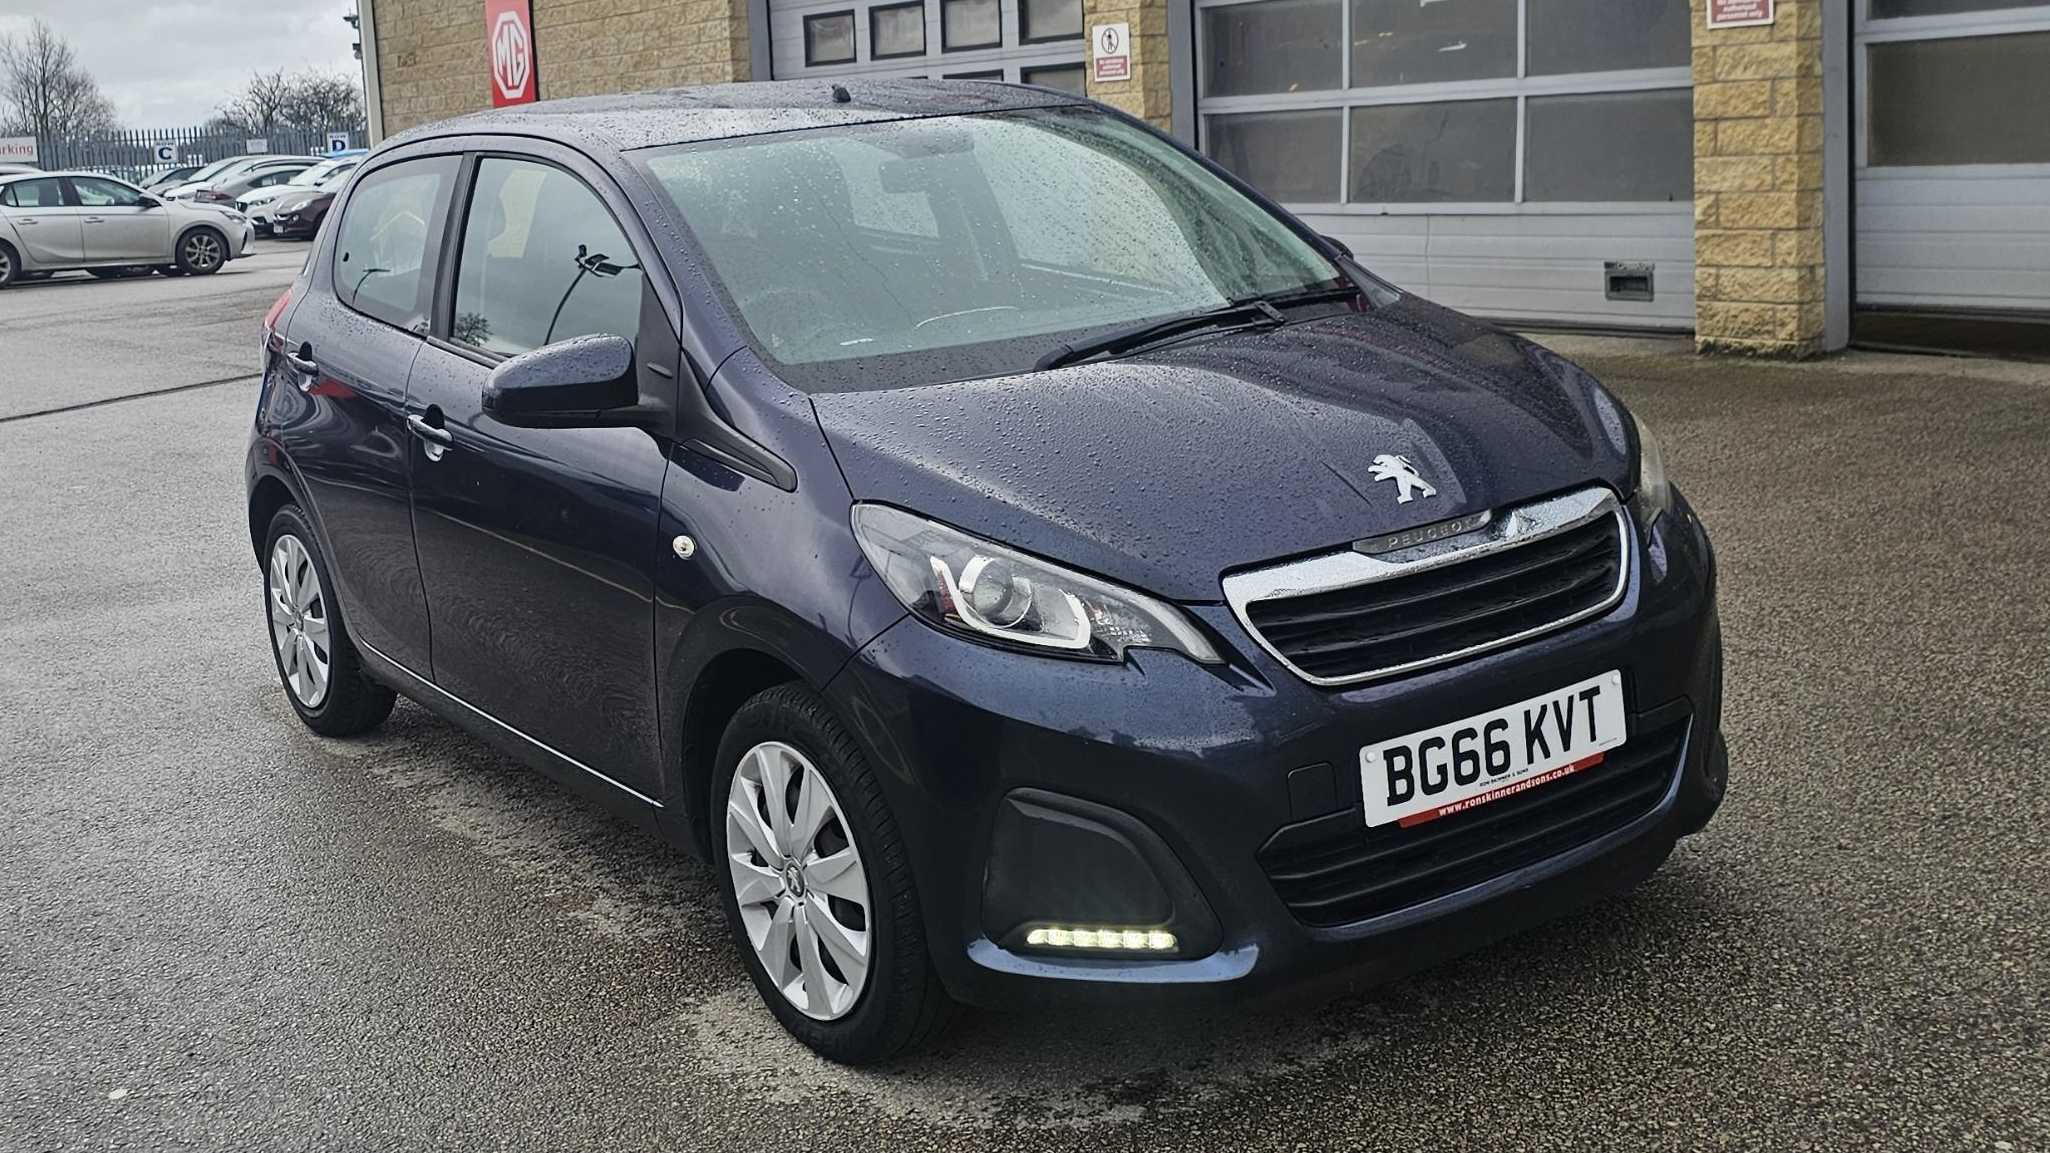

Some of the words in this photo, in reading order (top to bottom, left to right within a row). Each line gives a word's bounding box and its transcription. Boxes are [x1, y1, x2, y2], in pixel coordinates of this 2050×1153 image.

[495, 20, 526, 91] MG
[0, 144, 33, 156] rking
[158, 146, 172, 160] C
[331, 139, 346, 152] D
[1382, 718, 1511, 806] BG66
[1523, 685, 1601, 766] KVT
[1439, 765, 1575, 817] www.ronskinnerandsons.co.uk
